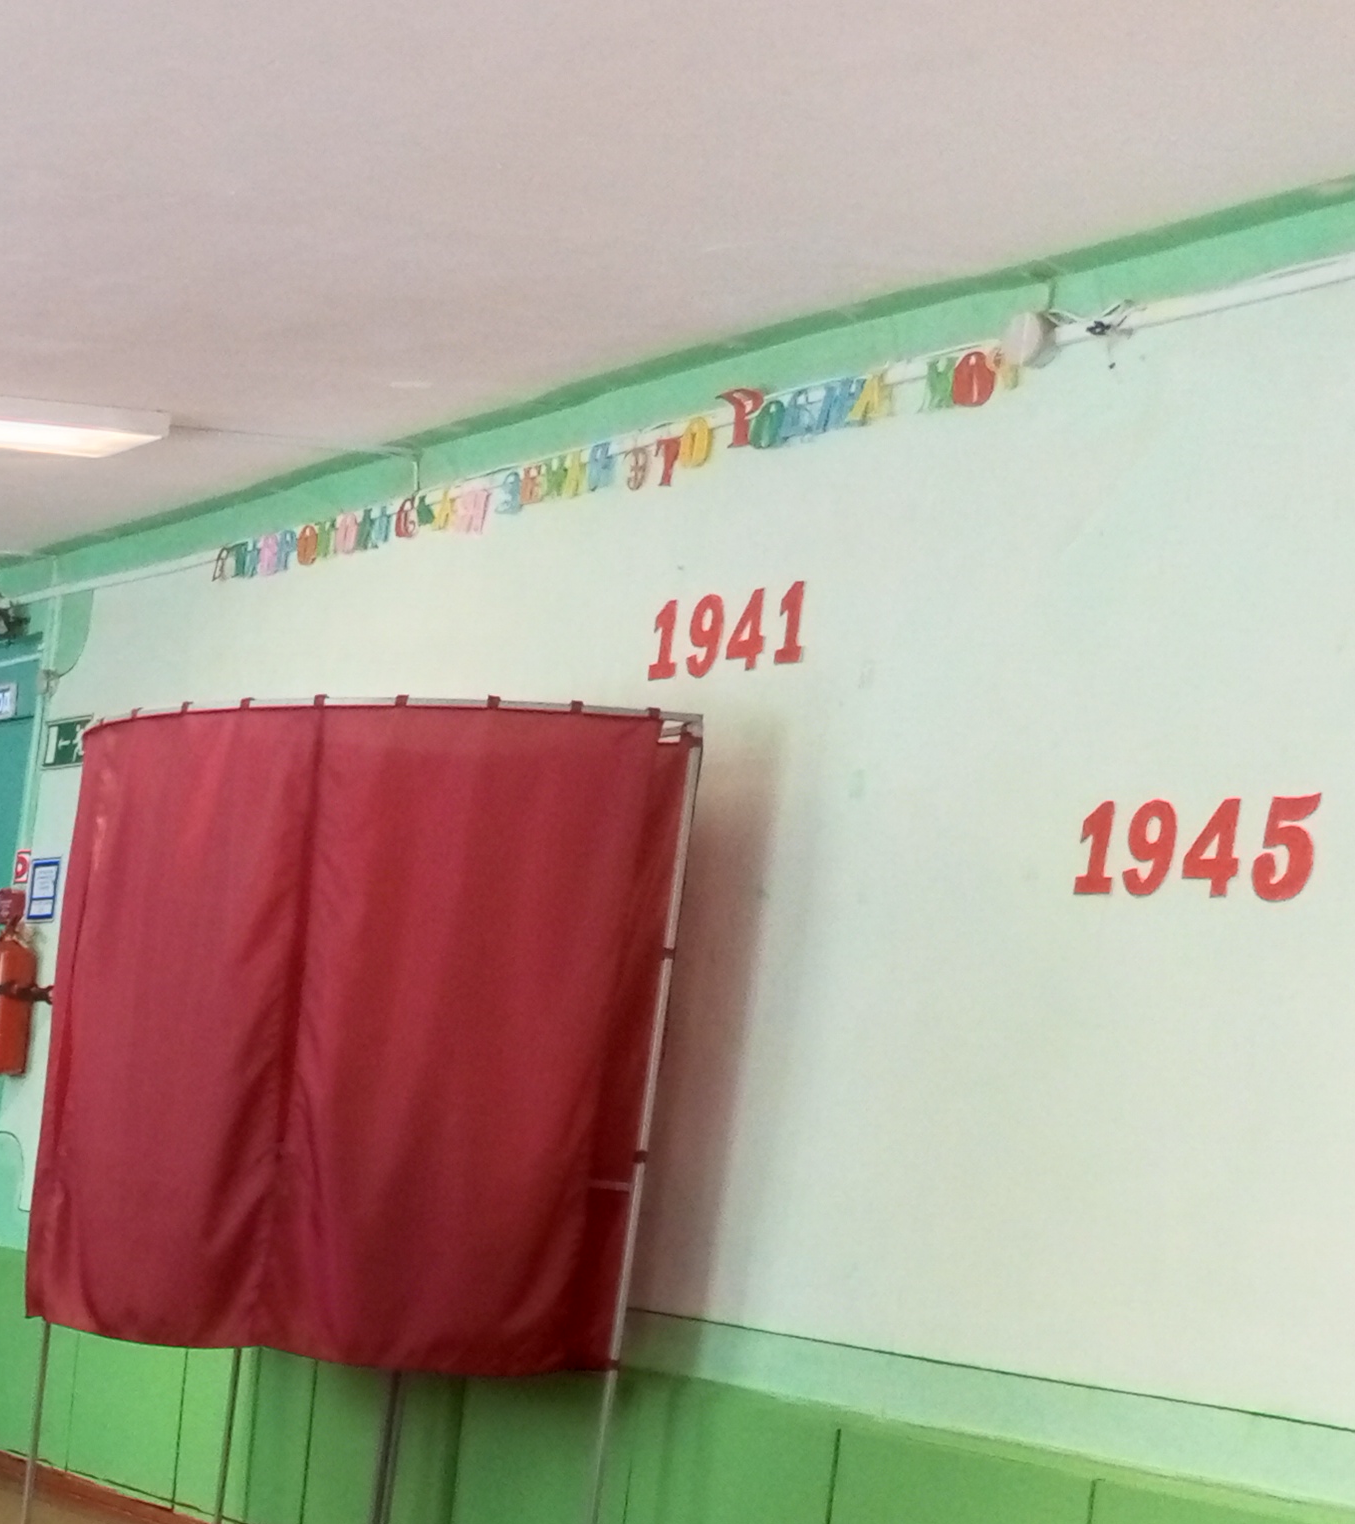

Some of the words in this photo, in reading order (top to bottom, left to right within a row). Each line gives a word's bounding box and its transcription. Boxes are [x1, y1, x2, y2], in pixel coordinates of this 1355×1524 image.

[494, 441, 614, 514] ЗЕМЛЯ
[625, 416, 714, 490] ЭТО
[716, 372, 893, 449] РОДИНА
[648, 580, 804, 681] 1941
[1073, 792, 1322, 902] 1945
